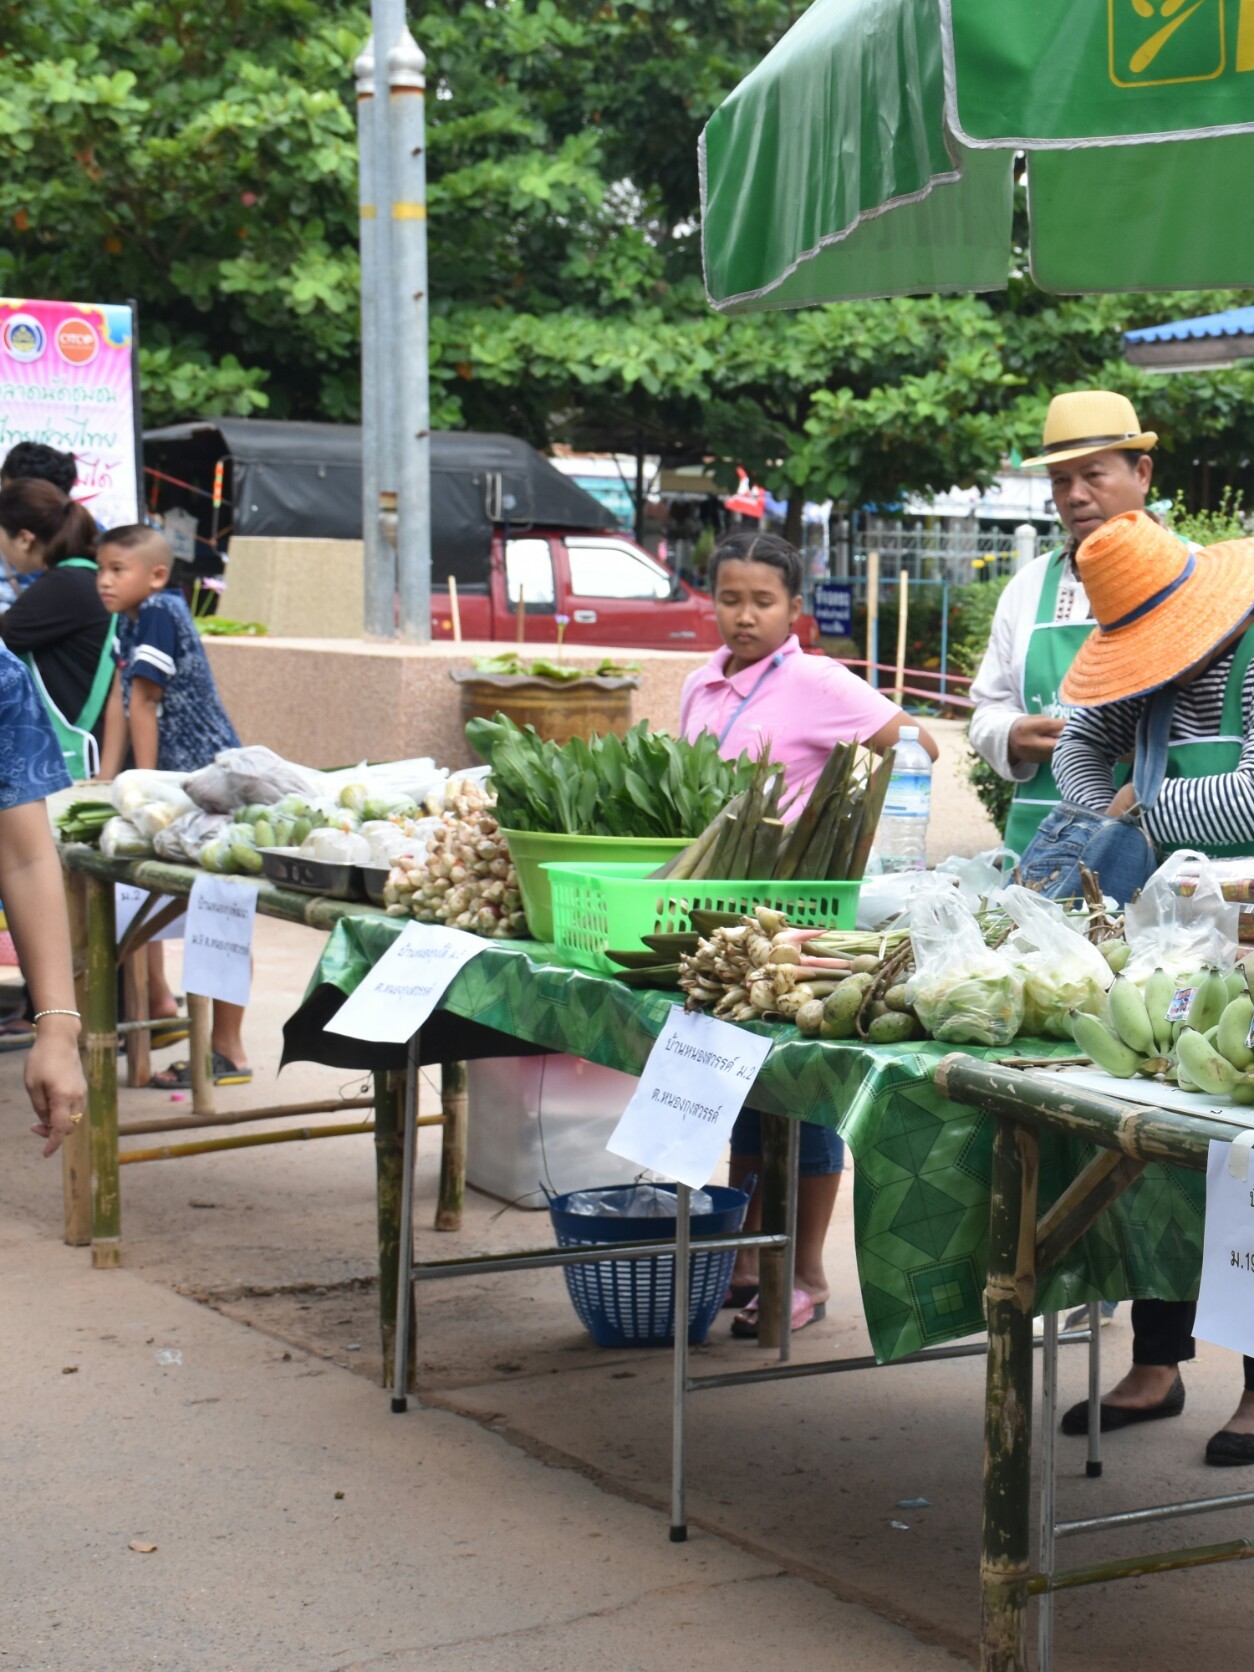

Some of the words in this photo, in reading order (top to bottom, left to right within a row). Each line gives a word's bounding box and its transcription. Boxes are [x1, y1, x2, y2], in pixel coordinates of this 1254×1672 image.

[0, 377, 117, 414] ลาดนัดชุมชน
